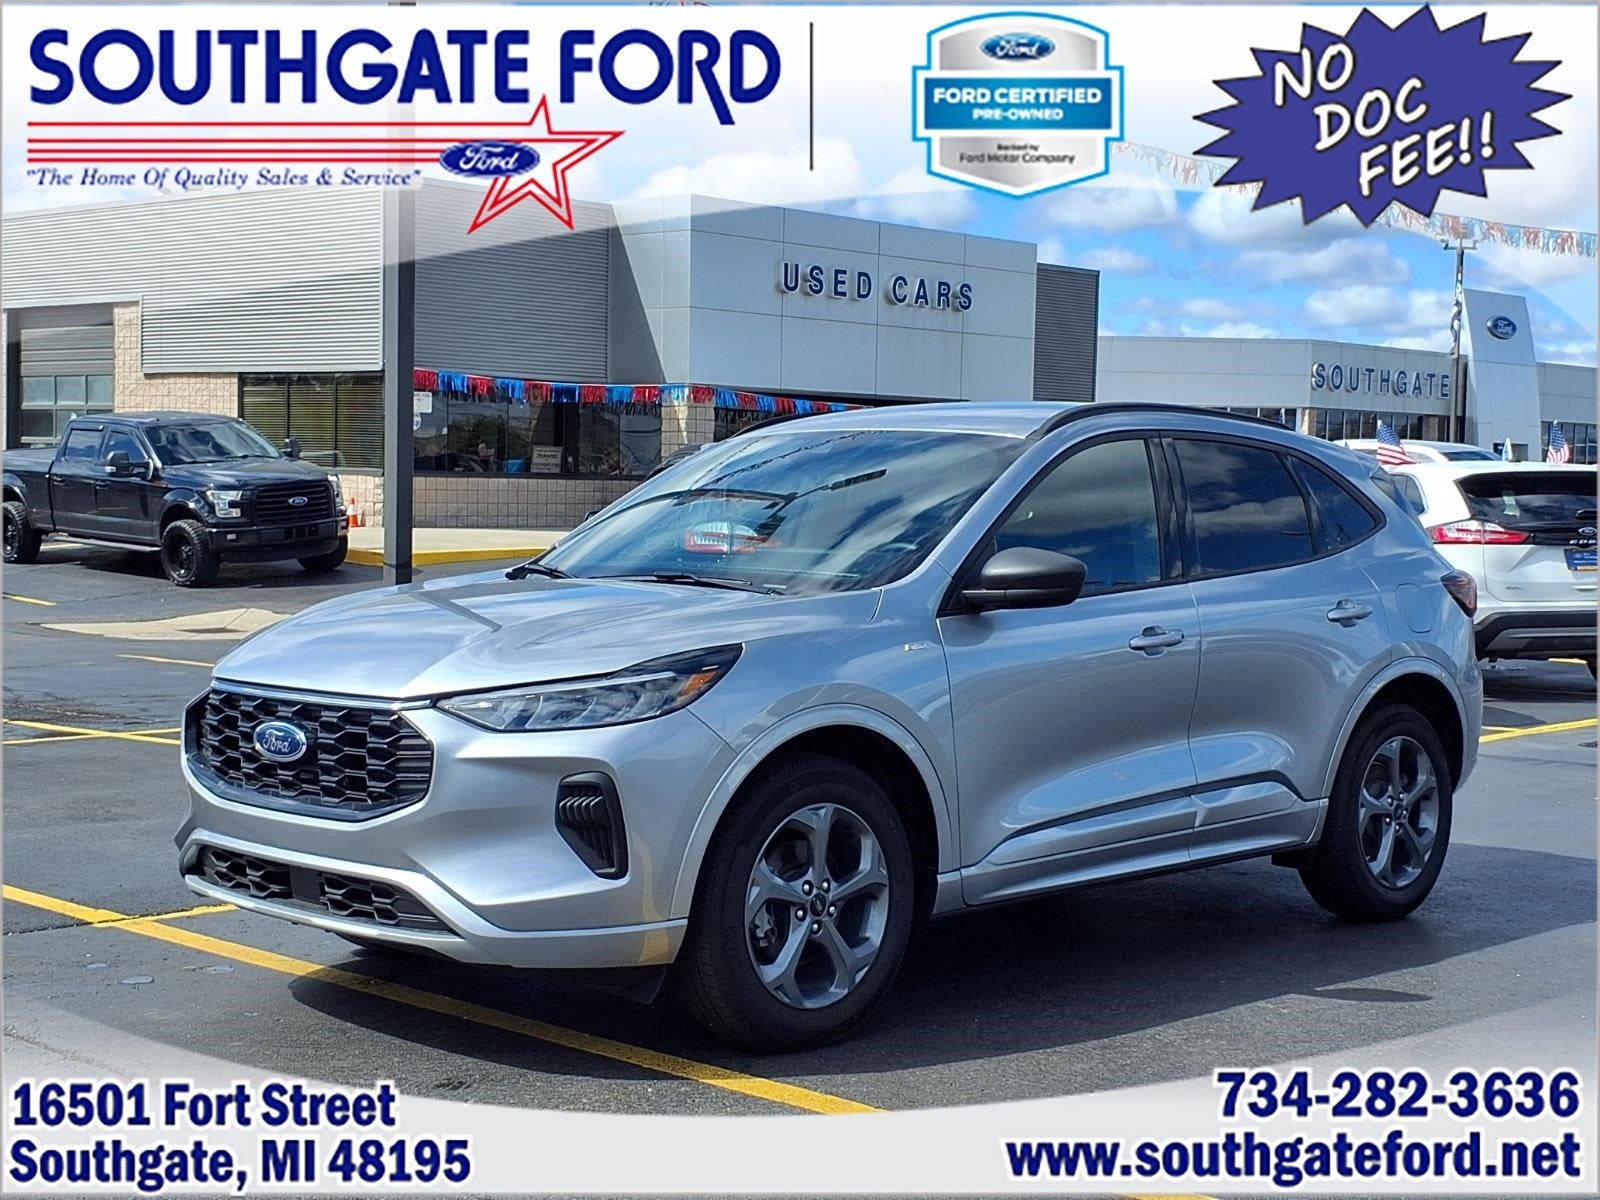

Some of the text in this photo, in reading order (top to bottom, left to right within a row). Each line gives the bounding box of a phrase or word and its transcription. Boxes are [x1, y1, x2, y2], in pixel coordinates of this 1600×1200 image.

[781, 261, 973, 312] USED CARS
[1312, 361, 1450, 399] SOUTHGATE
